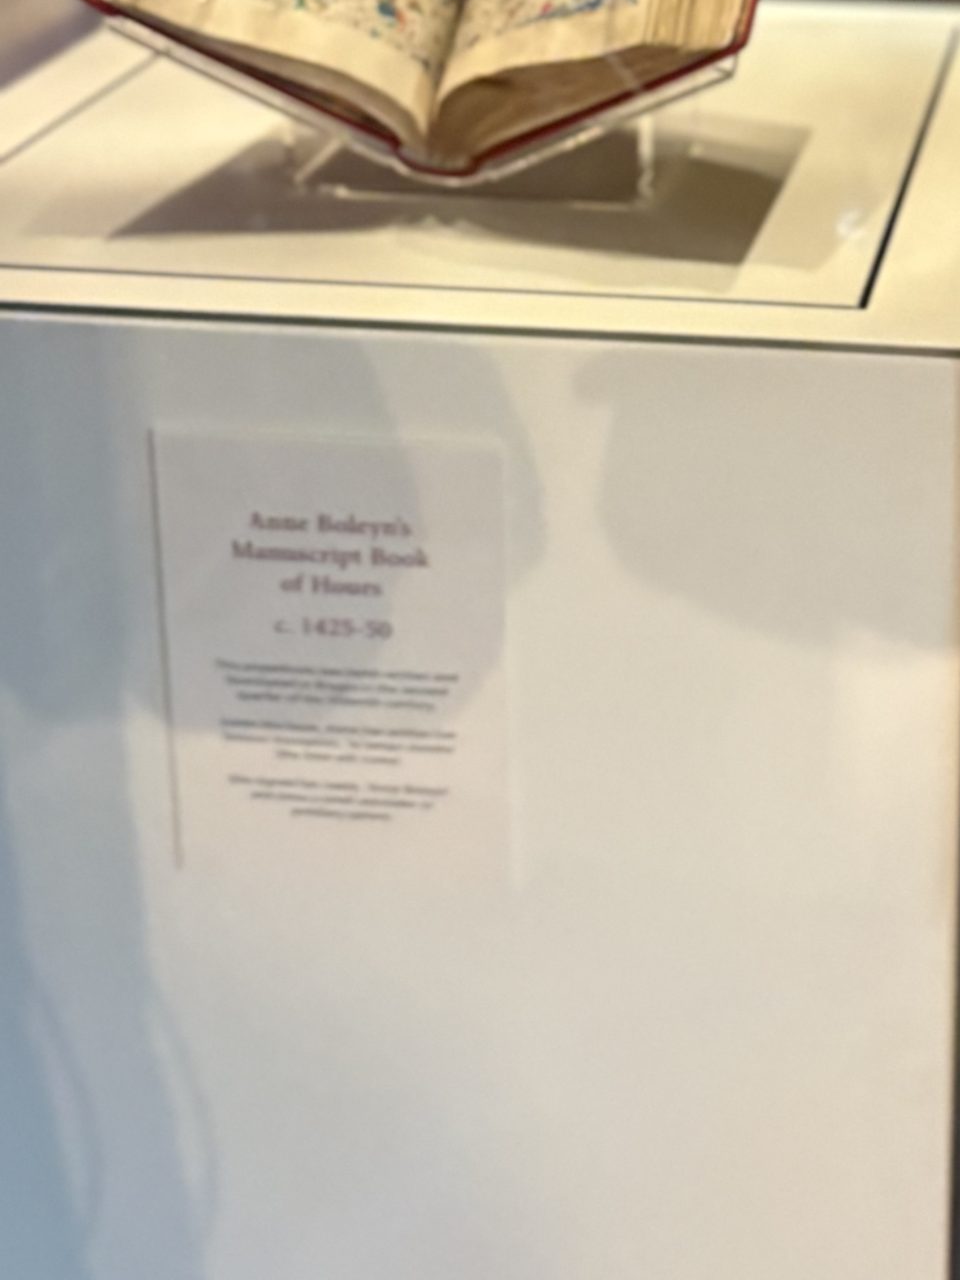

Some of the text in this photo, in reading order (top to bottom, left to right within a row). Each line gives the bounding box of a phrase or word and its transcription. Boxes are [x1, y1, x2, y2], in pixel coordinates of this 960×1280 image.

[249, 511, 412, 539] Anne Boleyn's
[231, 540, 429, 569] Manuscript Book
[280, 574, 383, 597] of Hours
